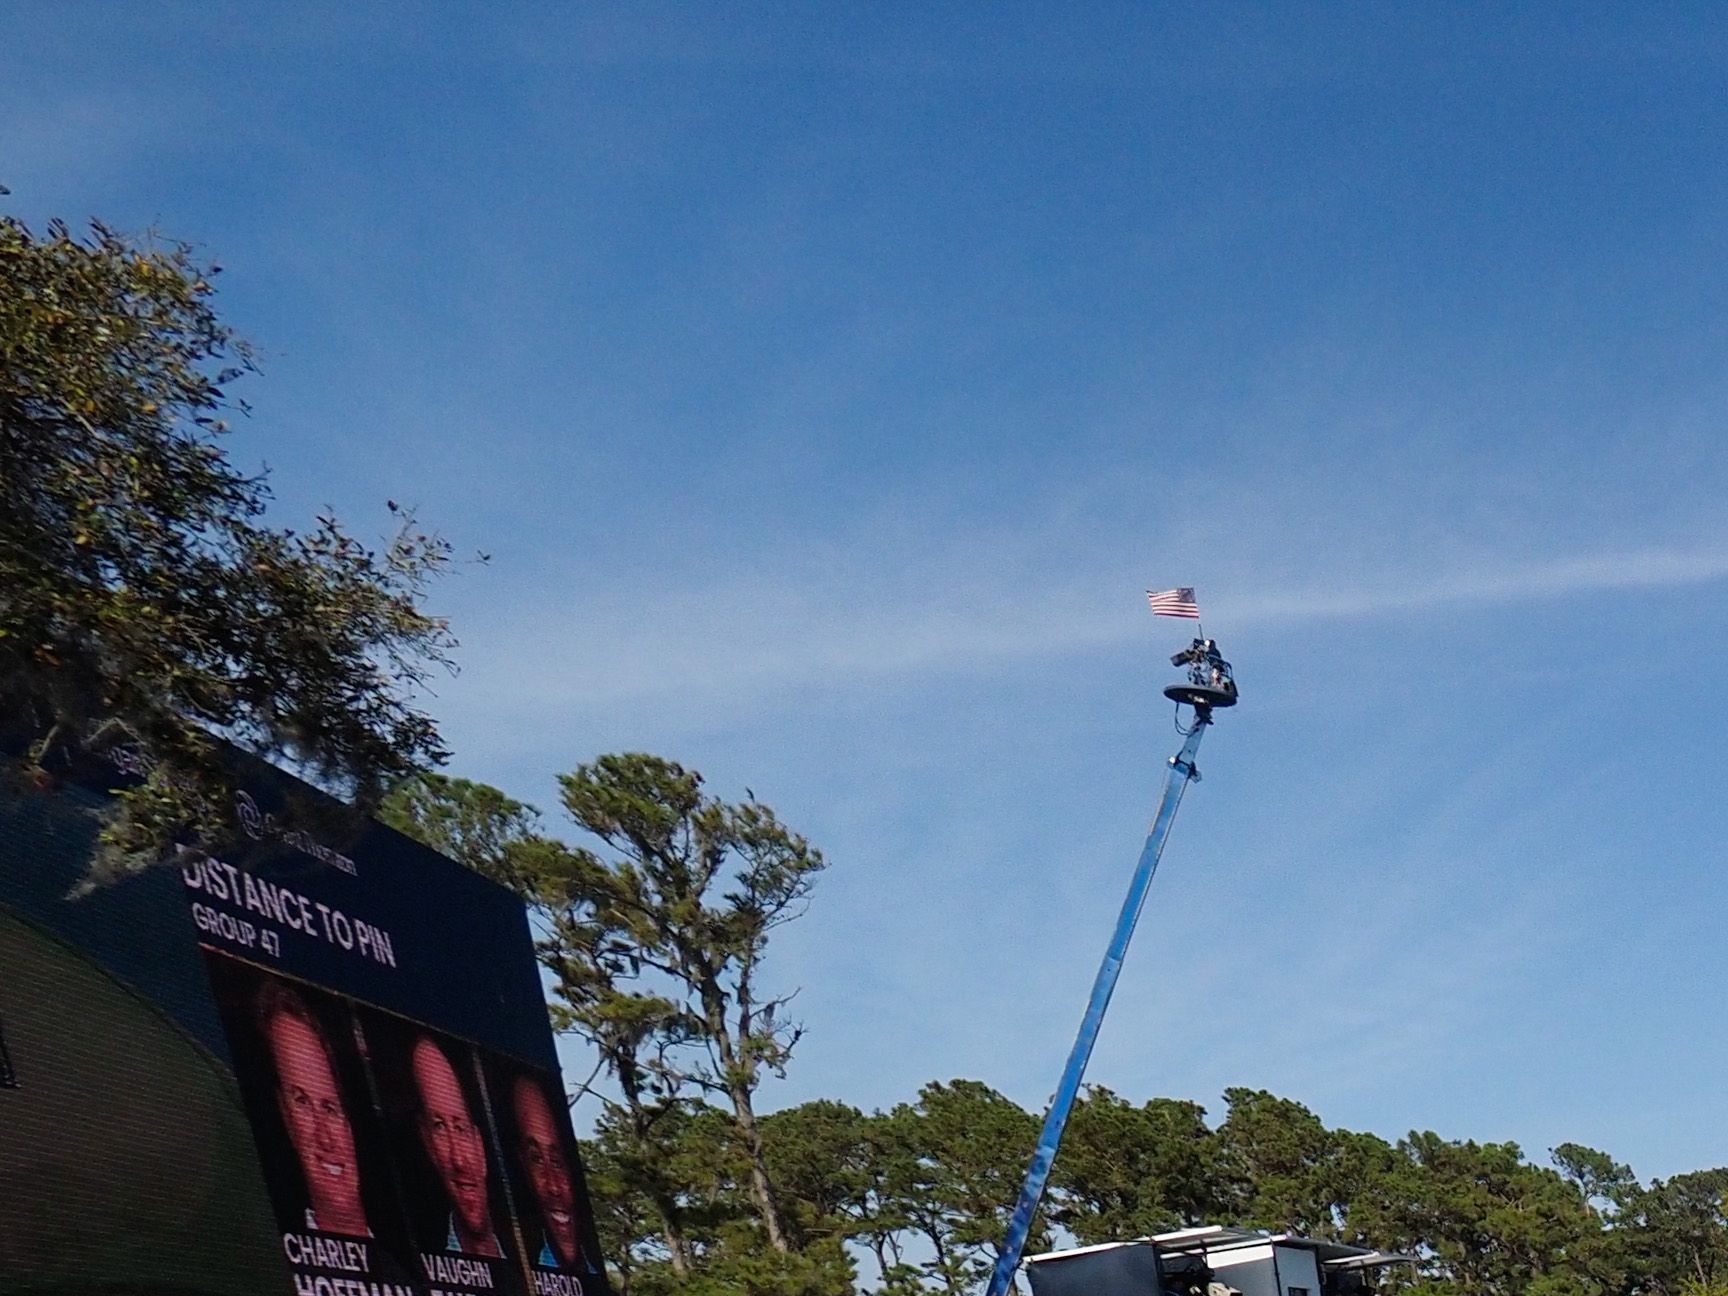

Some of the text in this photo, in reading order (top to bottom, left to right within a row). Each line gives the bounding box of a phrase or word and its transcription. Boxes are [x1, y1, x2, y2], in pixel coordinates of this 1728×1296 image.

[176, 843, 318, 937] DISTANCE
[315, 902, 354, 951] TO
[355, 918, 396, 968] PIN
[191, 902, 280, 958] GROUP 47
[284, 1234, 368, 1272] CHARLEY
[421, 1253, 494, 1288] VAUGHN
